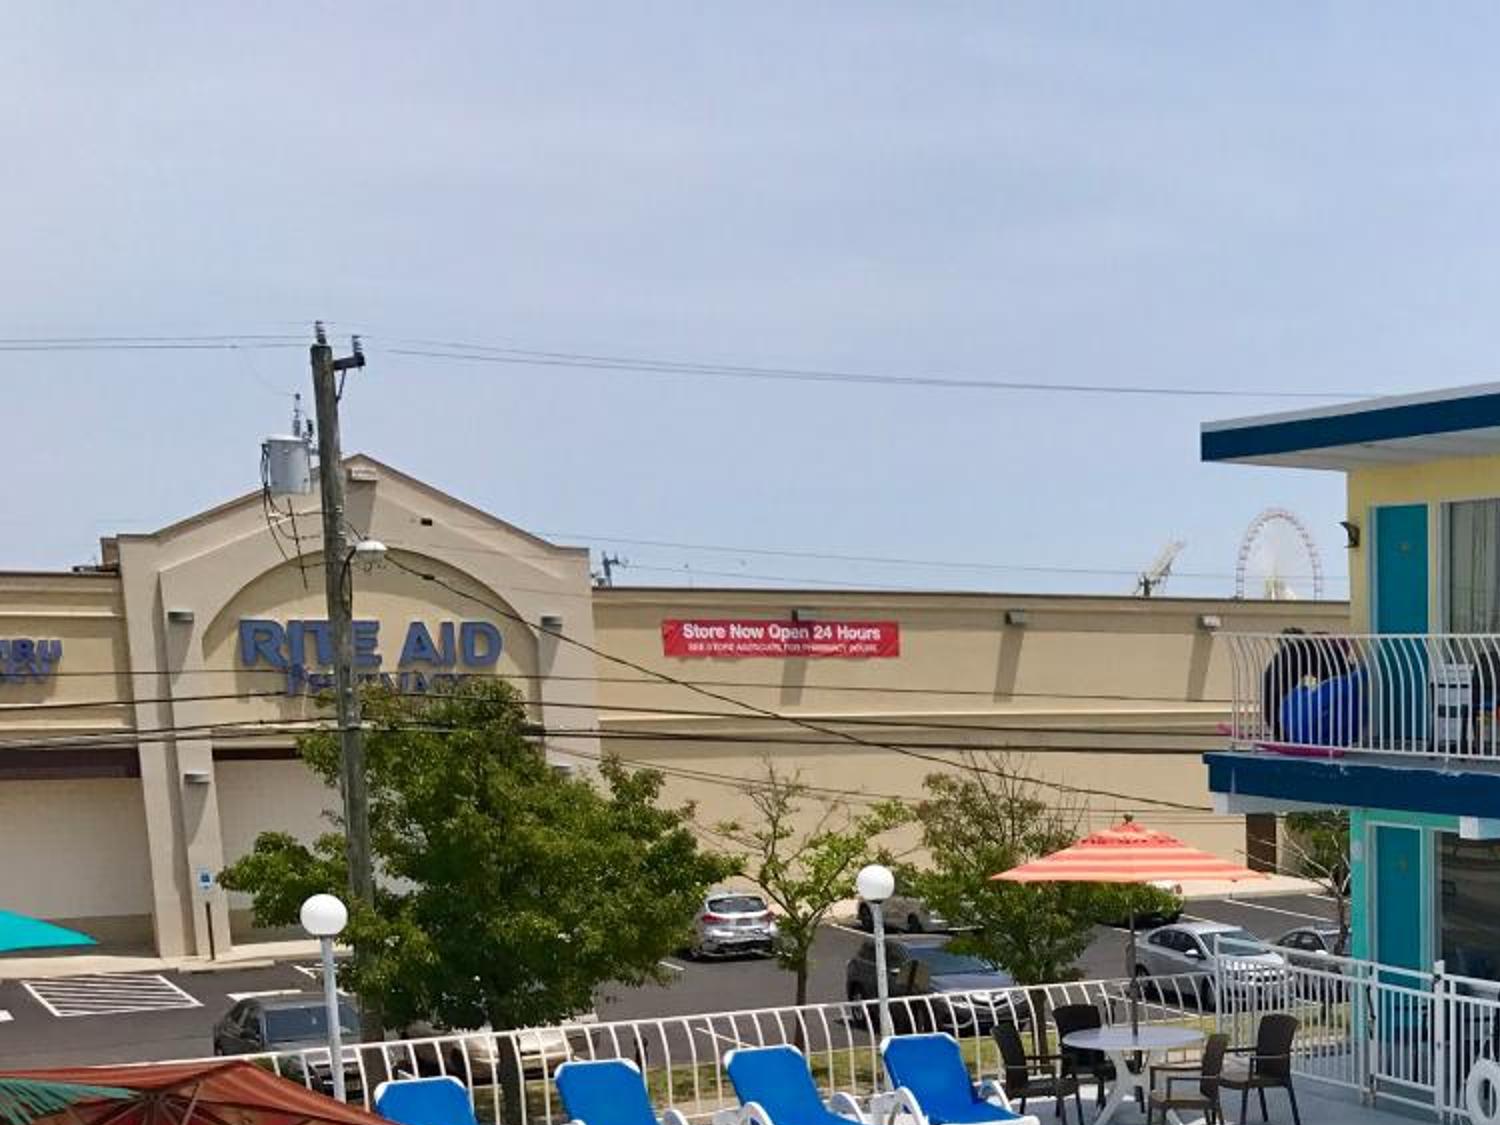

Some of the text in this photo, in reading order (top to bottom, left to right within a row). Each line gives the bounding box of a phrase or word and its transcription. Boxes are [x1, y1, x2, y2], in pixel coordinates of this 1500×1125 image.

[239, 620, 502, 669] RITE AID
[683, 623, 881, 642] Store Now Open 24 Hours
